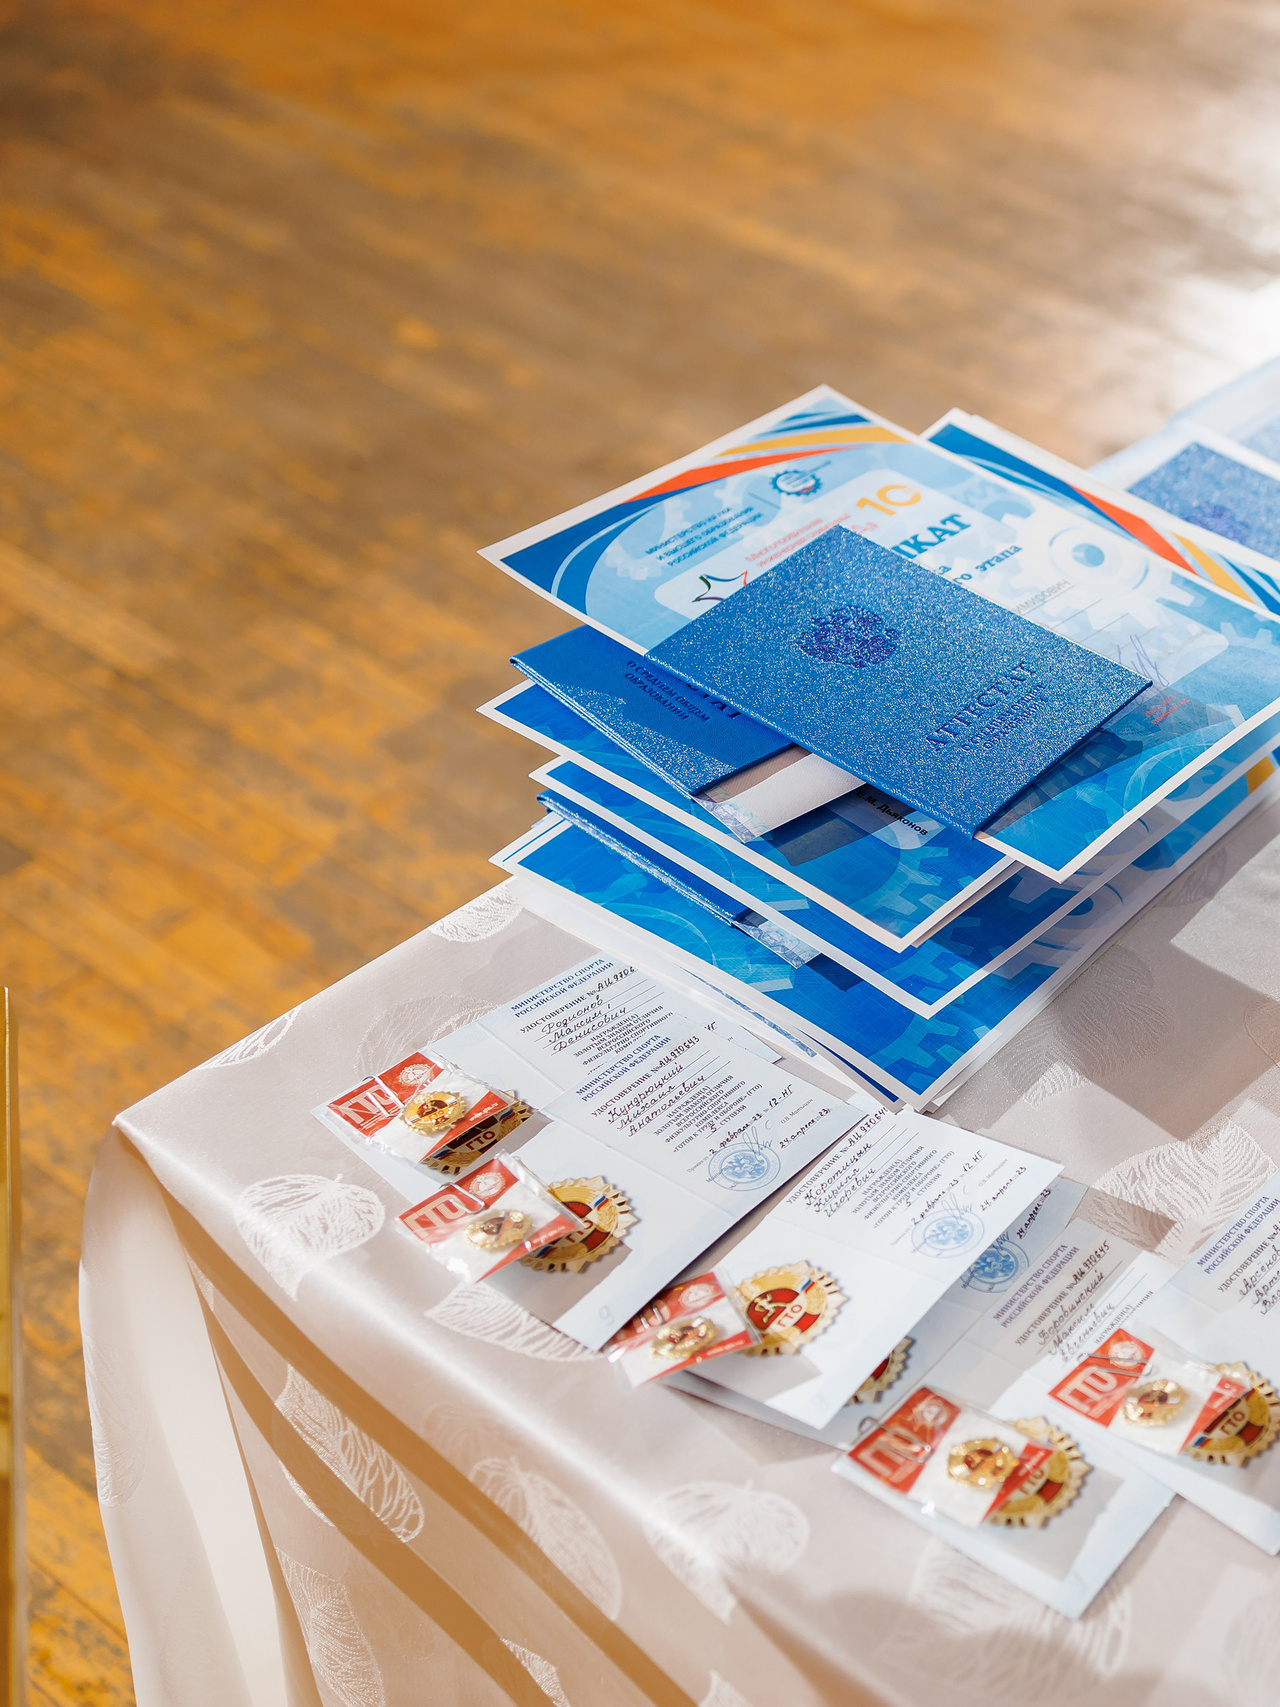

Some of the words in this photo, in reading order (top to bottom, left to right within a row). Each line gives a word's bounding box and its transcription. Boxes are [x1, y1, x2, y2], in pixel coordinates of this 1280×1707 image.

[975, 545, 1022, 572] этапа
[625, 673, 690, 720] ОБРАЗОВАНИИ
[636, 667, 678, 697] СРЕДНЕМ
[675, 696, 710, 722] ОБЩЕМ
[926, 661, 1036, 751] АТТЕСТАТ
[856, 790, 876, 806] Е.М.
[877, 803, 928, 836] Дьяконов
[511, 975, 573, 1011] МИНИСТЕРСТВО
[574, 959, 604, 976] СПОРТА
[514, 987, 567, 1017] РОССИЙСКОЙ
[571, 962, 613, 986] ФЕДЕРАЦИИ
[520, 995, 584, 1033] УДОСТОВЕРЕНИЕ
[541, 994, 602, 1031] Родионов
[548, 1010, 601, 1042] Максим
[553, 1007, 625, 1050] Денисович
[573, 1039, 603, 1055] ЗОЛОТЫМ
[609, 1024, 633, 1037] ЗНАКОМ
[633, 1005, 663, 1024] ОТЛИЧИЯ
[590, 1013, 638, 1041] НАГРАЖДЕН(А)
[596, 1019, 650, 1048] ВСЕРОССИЙСКОГО
[575, 1053, 632, 1093] МИНИСТЕРСТВО
[633, 1035, 660, 1054] СПОРТА
[581, 1066, 630, 1101] РОССИЙСКОЙ
[632, 1036, 671, 1066] ФЕДЕРАЦИИ
[593, 1073, 649, 1116] УДОСТОВЕРЕНИЕ
[607, 1061, 681, 1122] Кундрюцкий
[616, 1086, 672, 1129] Михаил
[630, 1075, 704, 1134] Анатольевич
[655, 1112, 680, 1134] ЗОЛОТЫМ
[685, 1096, 705, 1111] ЗНАКОМ
[704, 1075, 732, 1095] ОТЛИЧИЯ
[666, 1085, 710, 1117] НАГРАЖДЕН(А)
[668, 1081, 745, 1142] ФИЗКУЛЬТУРНО-СПОРТИВНОГО
[680, 1089, 724, 1122] ВСЕРОССИЙСКОГО
[695, 1101, 727, 1126] КОМПЛЕКСА
[465, 1131, 495, 1150] ГТО
[673, 1137, 691, 1152] «ГОТОВ
[698, 1120, 714, 1133] ТРУДУ
[719, 1096, 744, 1116] ОБОРОНЕ»
[746, 1084, 762, 1096] (ГТО)
[707, 1123, 720, 1133] 5
[720, 1106, 743, 1125] СТУПЕНИ
[786, 1154, 839, 1203] УДОСТОВЕРЕНИЕ
[823, 1168, 875, 1217] Игоревич
[852, 1189, 878, 1212] ЗОЛОТЫМ
[879, 1168, 898, 1188] ЗНАКОМ
[899, 1146, 922, 1168] ОТЛИЧИЯ
[861, 1158, 902, 1195] НАГРАЖДЕН(А)
[864, 1149, 937, 1219] ФИЗКУЛЬТУРНО-СПОРТИВНОГО
[873, 1161, 916, 1201] ВСЕРОССИЙСКОГО
[892, 1171, 921, 1200] КОМПЛЕКСА
[896, 1192, 910, 1205] ТРУДУ
[939, 1150, 954, 1164] (ГТО)
[917, 1173, 940, 1195] СТУПЕНИ
[1197, 1218, 1245, 1265] МИНИСТЕРСТВО
[1245, 1196, 1269, 1219] СПОРТА
[1205, 1233, 1246, 1274] РОССИЙСКОЙ
[1243, 1198, 1280, 1234] ФЕДЕРАЦИИ
[993, 1268, 1043, 1318] МИНИСТЕРСТВО
[1042, 1244, 1067, 1269] СПОРТА
[1000, 1284, 1044, 1328] РОССИЙСКОЙ
[1041, 1246, 1079, 1283] ФЕДЕРАЦИИ
[1219, 1240, 1269, 1291] УДОСТОВЕРЕНИЕ
[777, 1304, 803, 1327] ГТО
[1015, 1290, 1068, 1344] УДОСТОВЕРЕНИЕ
[1094, 1304, 1134, 1344] НАГРАЖДЕН(А)
[1221, 1411, 1245, 1435] ГТО
